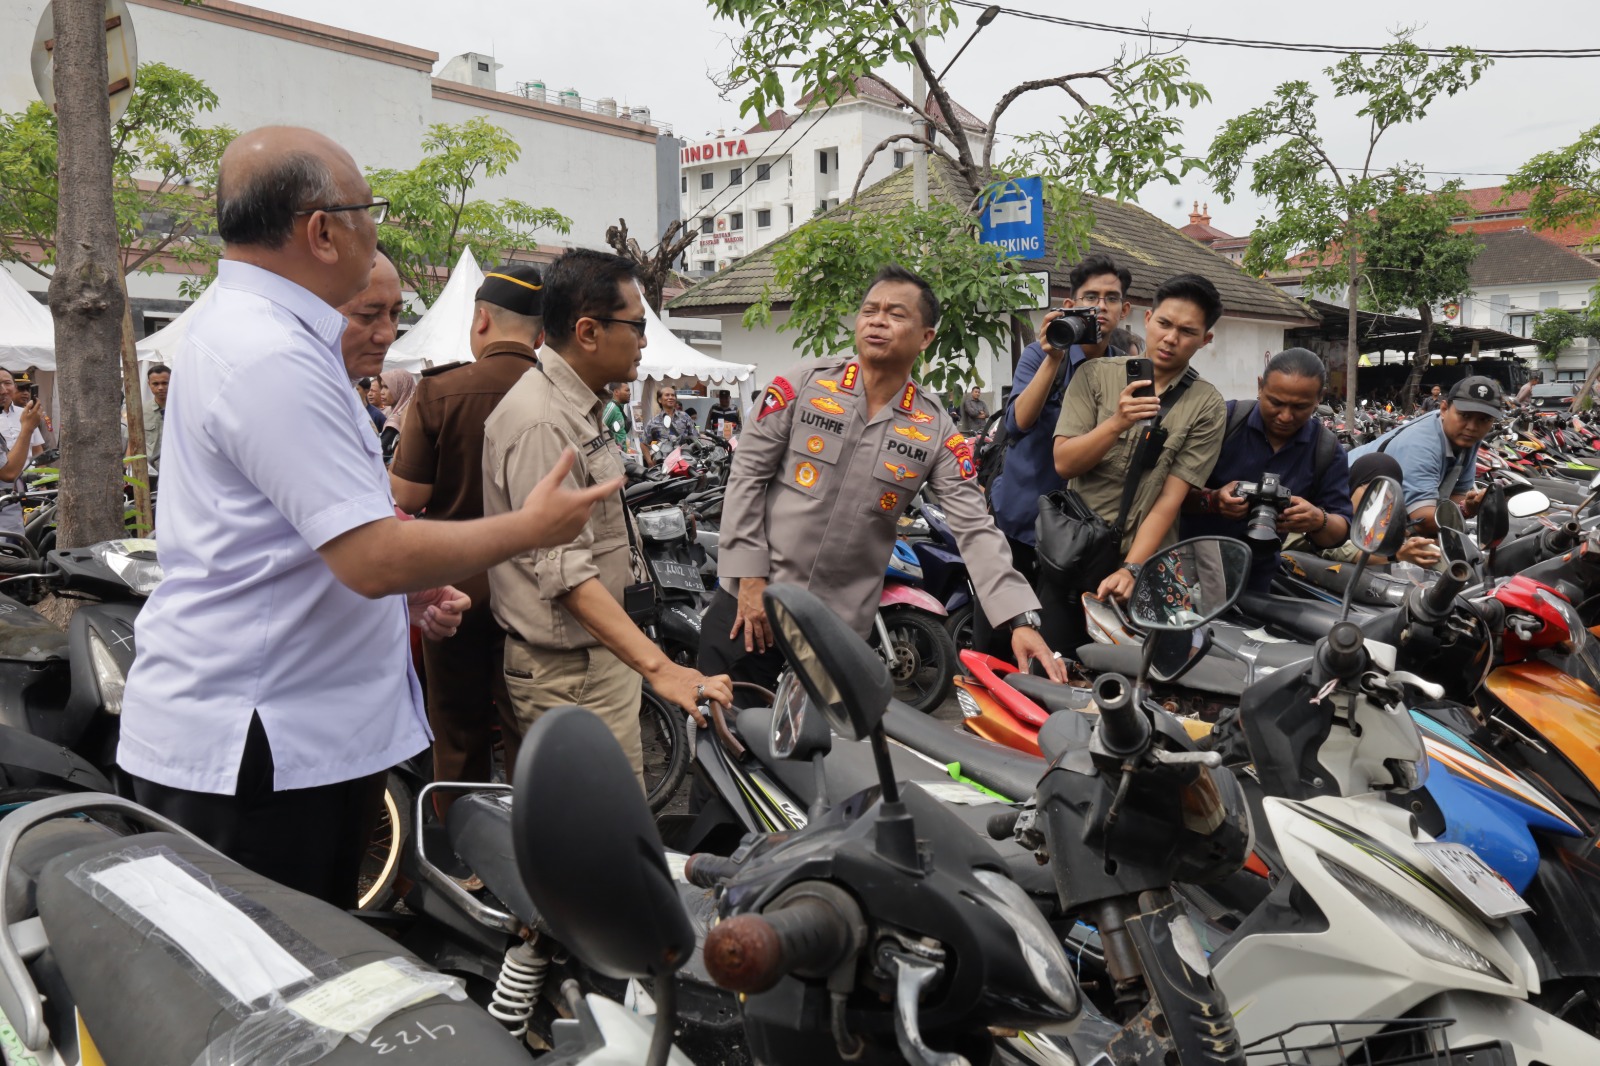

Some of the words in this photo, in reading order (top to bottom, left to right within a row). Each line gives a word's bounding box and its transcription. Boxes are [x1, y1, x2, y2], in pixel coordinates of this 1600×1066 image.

[681, 139, 748, 164] INDITA
[800, 410, 845, 435] LUTHFIE
[887, 440, 928, 462] POLRI
